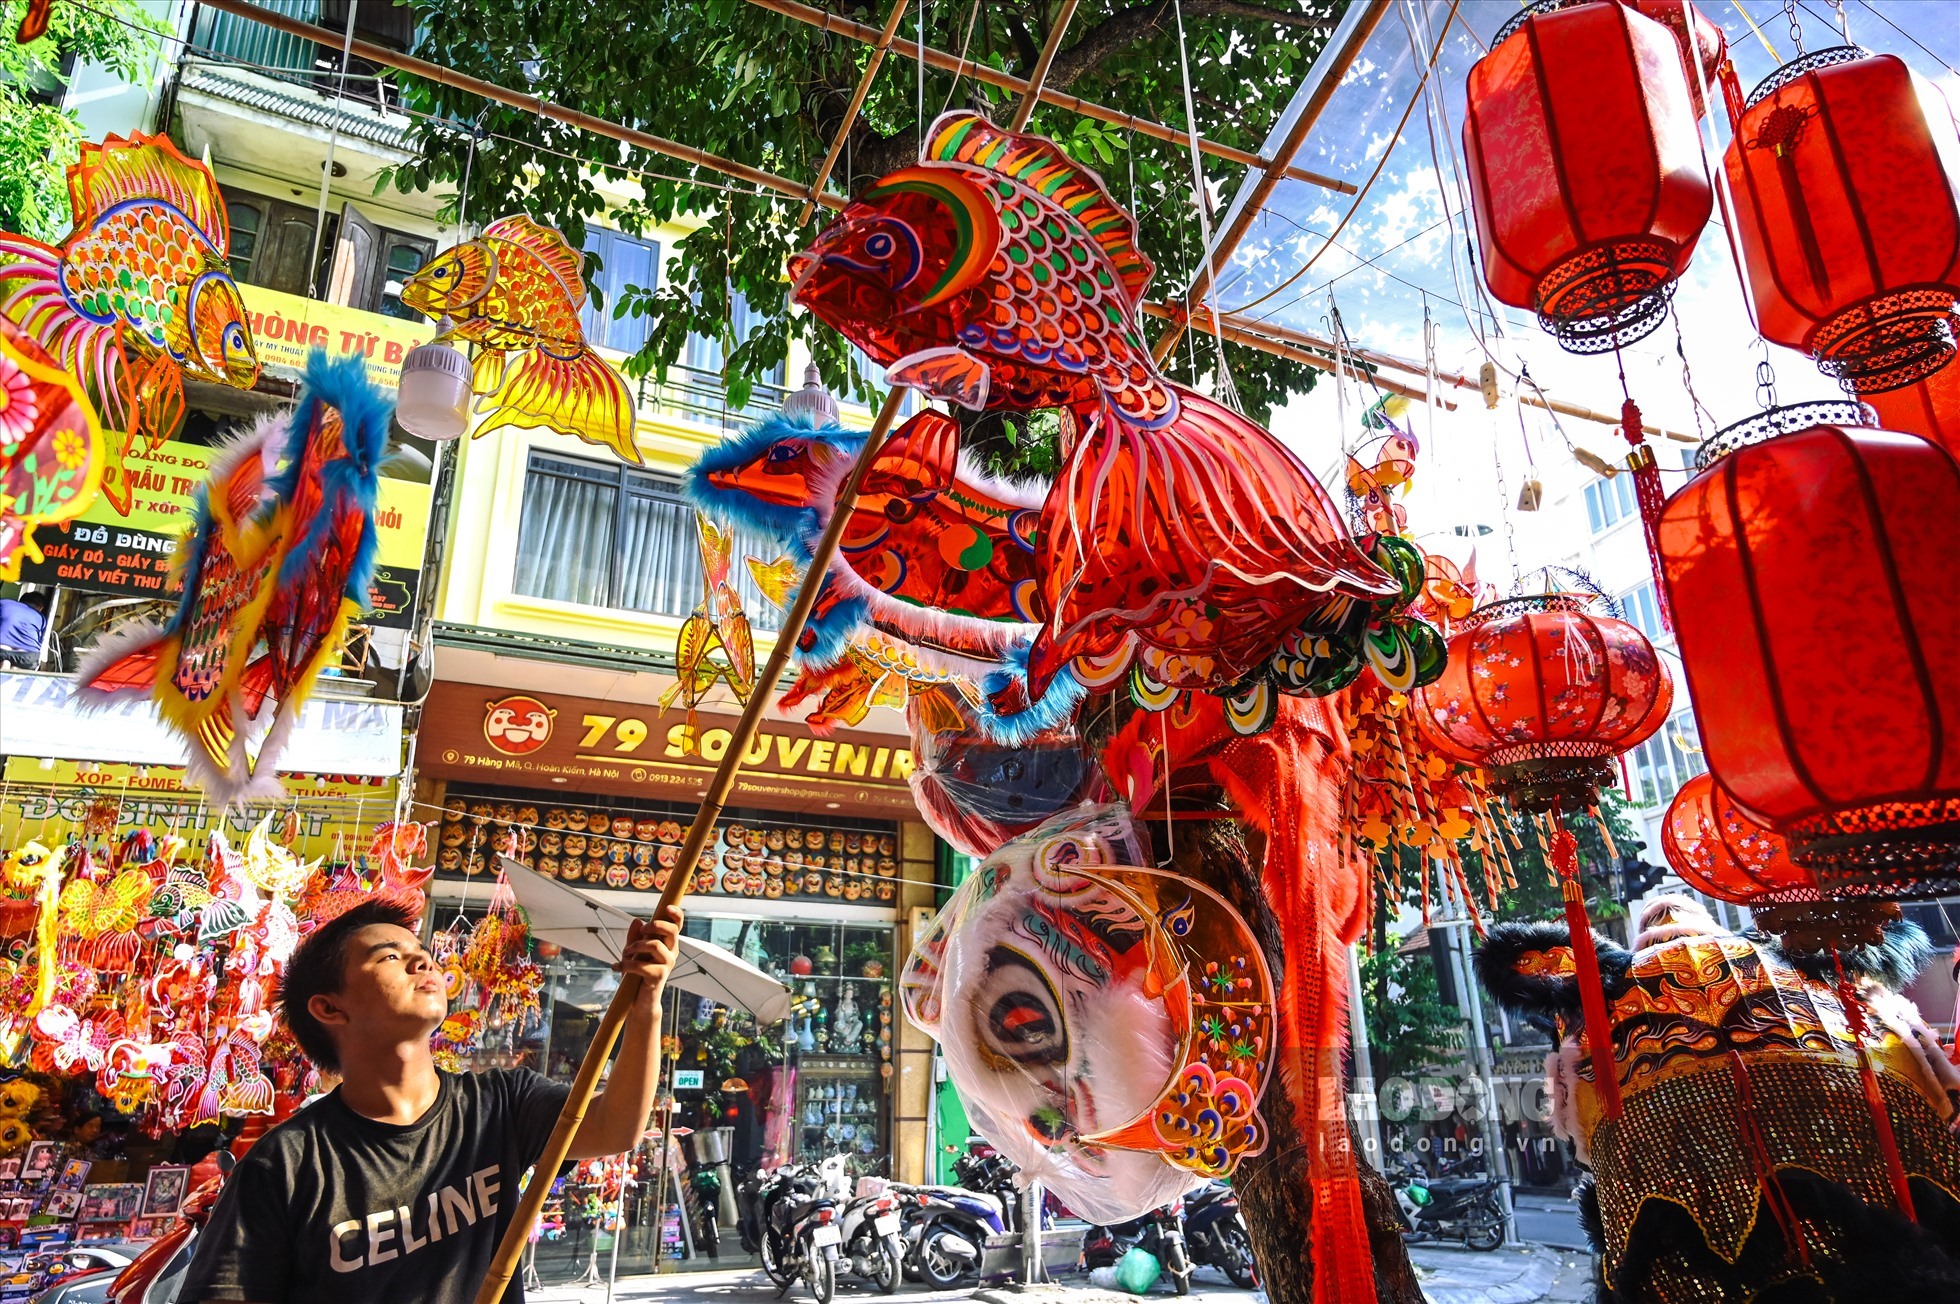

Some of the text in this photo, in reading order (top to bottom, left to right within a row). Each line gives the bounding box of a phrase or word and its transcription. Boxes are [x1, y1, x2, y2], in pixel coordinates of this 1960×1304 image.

[247, 310, 329, 350] HÒNG
[74, 525, 178, 553] ĐỒ DÙNG
[578, 714, 918, 781] 79 SOUVENIR
[463, 755, 476, 765] 79
[478, 756, 503, 769] Hàng
[536, 763, 561, 773] Hoàn
[588, 768, 601, 776] Hà
[603, 769, 620, 779] Nội
[678, 1076, 699, 1086] OPEN
[329, 1163, 500, 1273] CELINE
